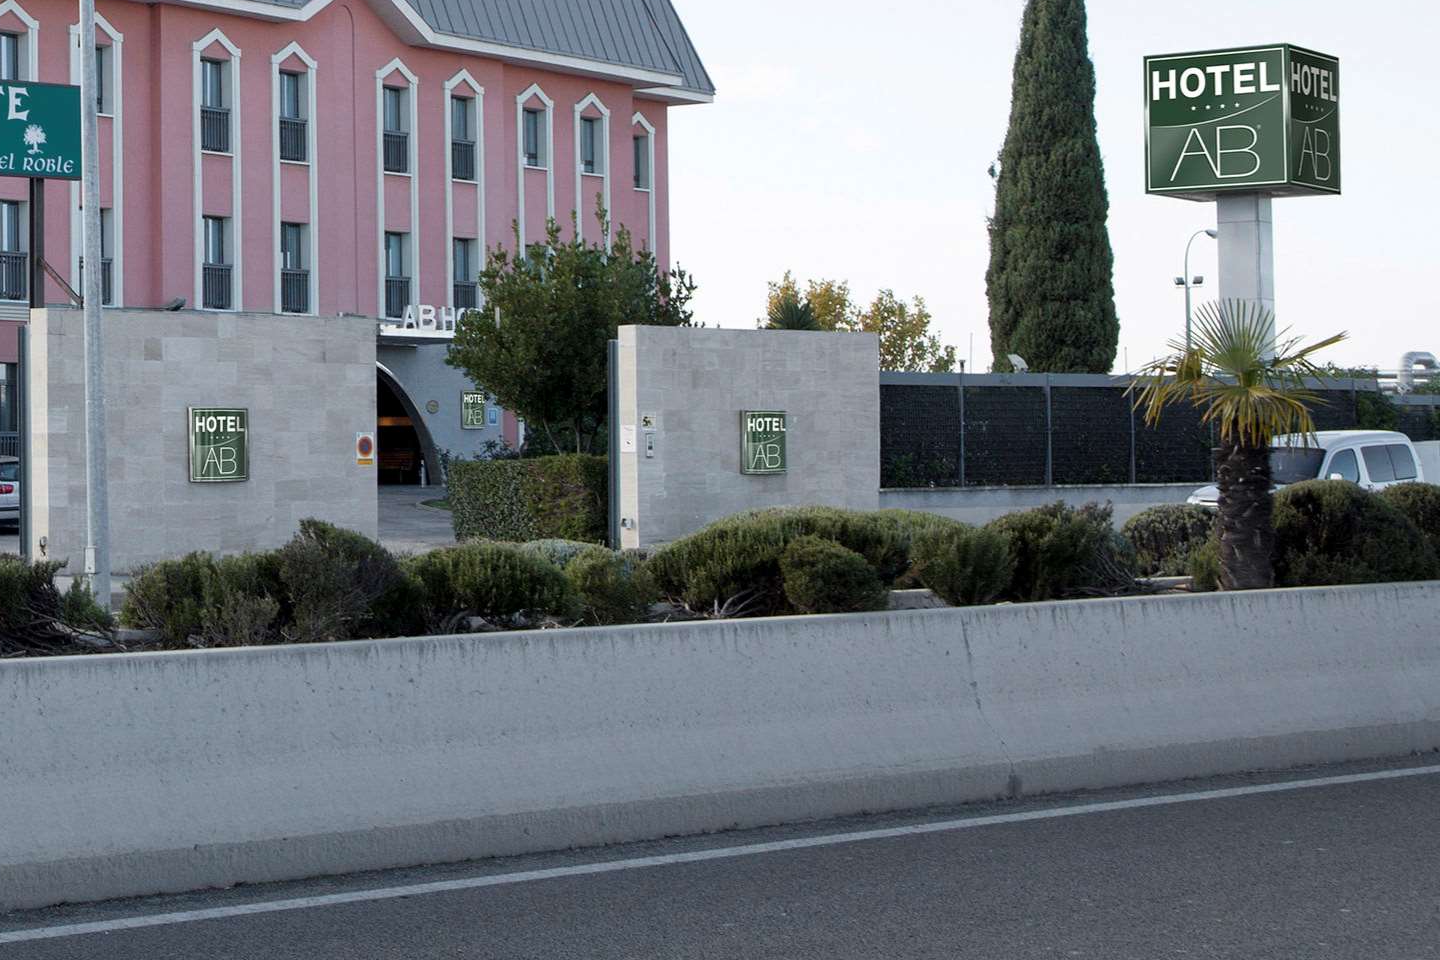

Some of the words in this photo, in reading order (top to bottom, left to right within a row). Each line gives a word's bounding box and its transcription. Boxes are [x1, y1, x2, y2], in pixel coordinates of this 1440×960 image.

[1152, 61, 1280, 101] HOTEL
[1290, 61, 1337, 102] HOTEL
[1170, 125, 1261, 182] AB
[1298, 125, 1332, 181] AB
[463, 394, 485, 403] HOTEL
[195, 416, 245, 433] HOTEL
[747, 418, 786, 432] HOTEL
[202, 447, 237, 474] AB
[752, 444, 781, 468] AB
